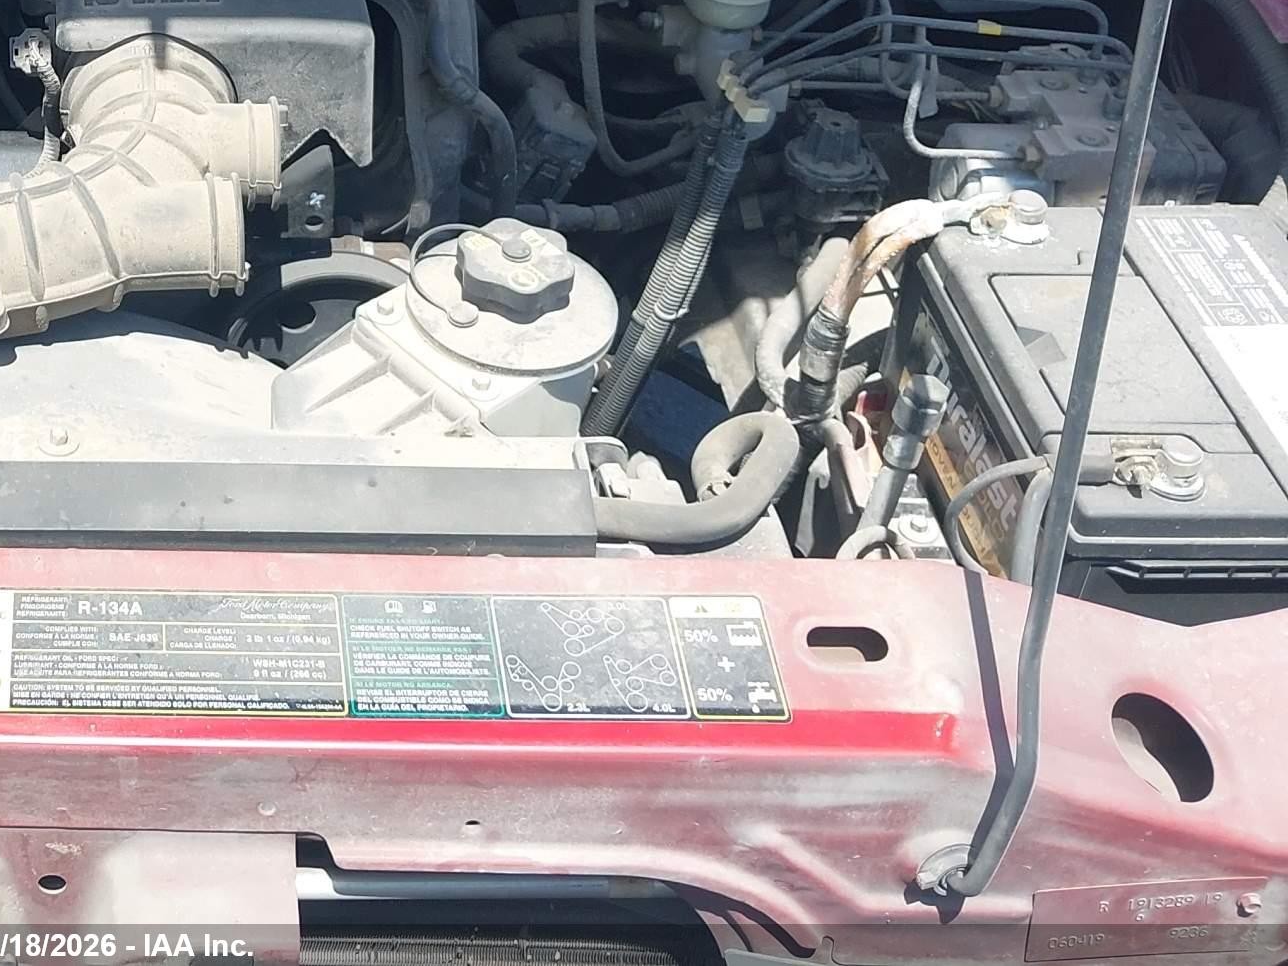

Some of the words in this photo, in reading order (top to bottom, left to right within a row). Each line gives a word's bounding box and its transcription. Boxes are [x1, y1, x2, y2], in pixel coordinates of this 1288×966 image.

[78, 600, 143, 615] R-134A
[684, 628, 719, 643] 50%
[697, 688, 733, 702] 50%
